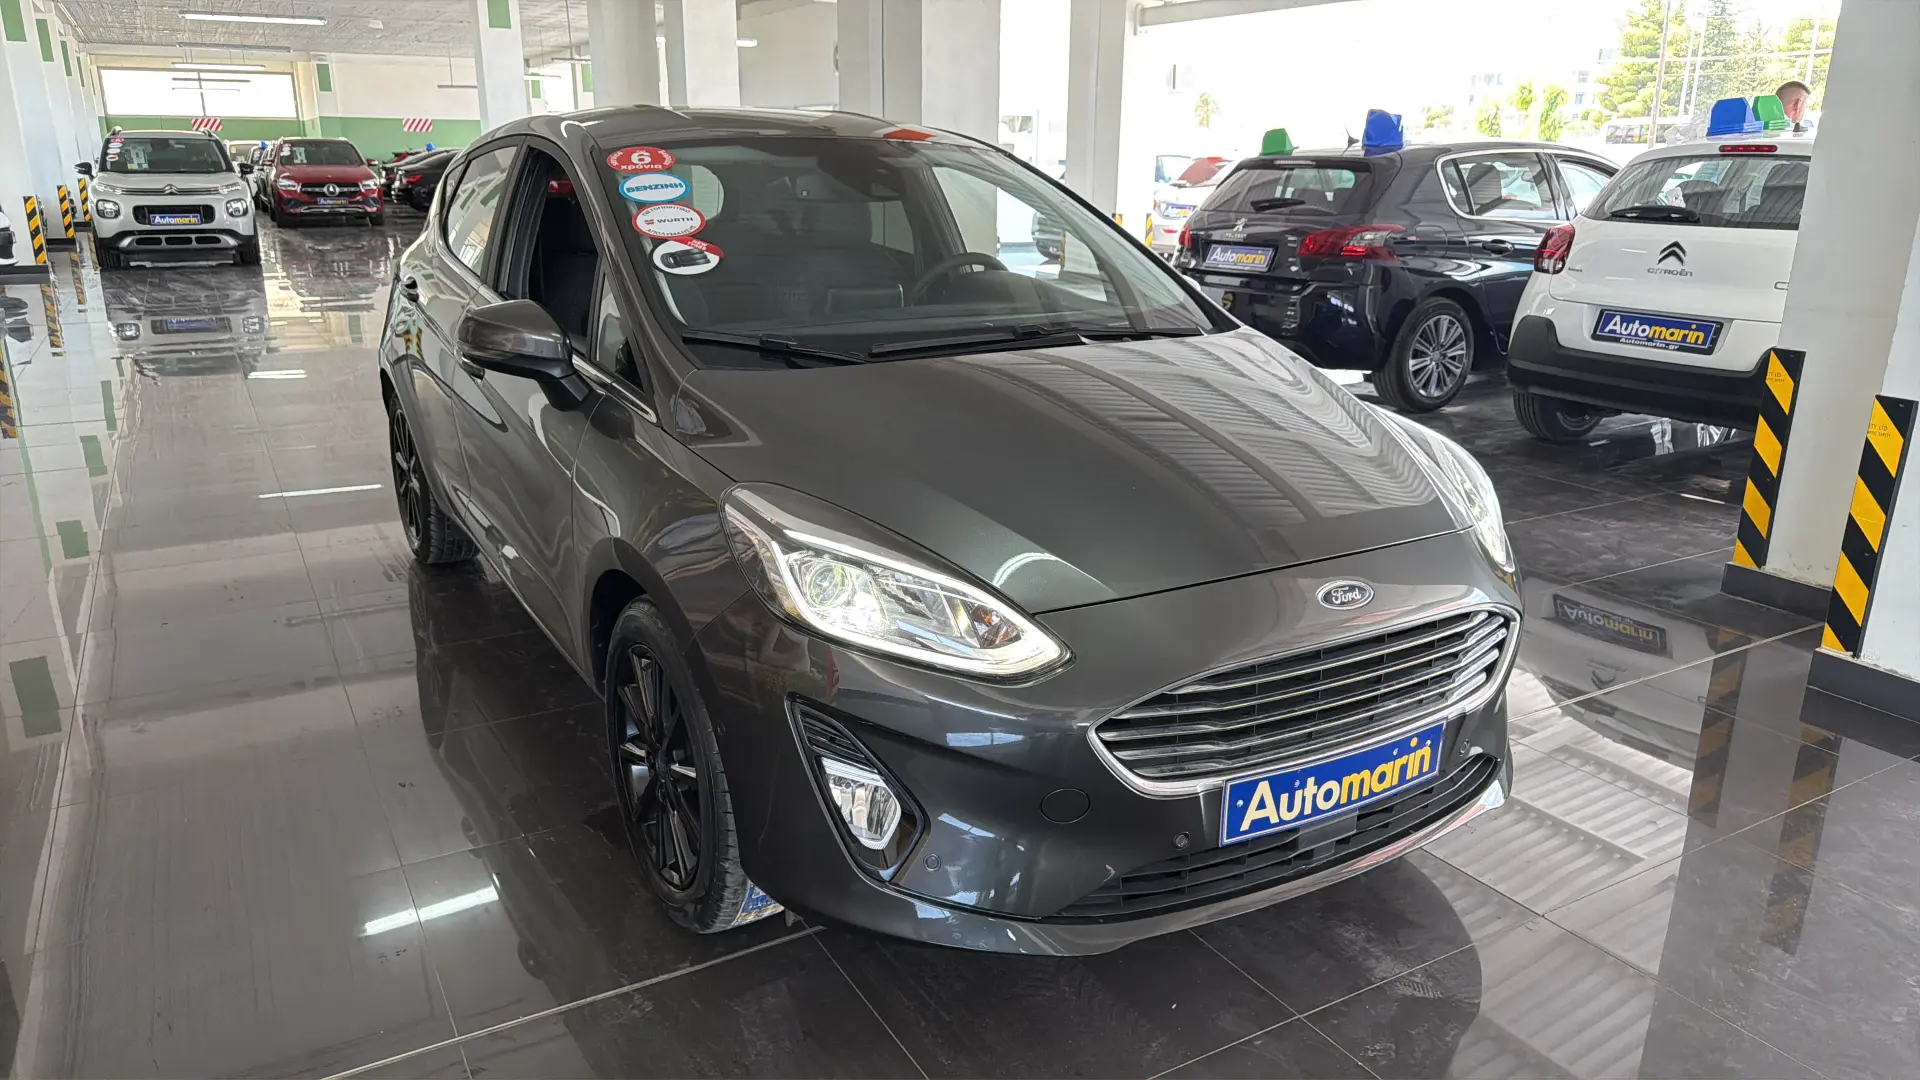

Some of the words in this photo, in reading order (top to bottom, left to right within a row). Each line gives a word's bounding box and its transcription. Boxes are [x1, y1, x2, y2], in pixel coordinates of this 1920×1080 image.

[631, 152, 651, 165] 6
[154, 215, 198, 224] Automarin
[1210, 247, 1266, 265] Automarin
[1604, 315, 1705, 345] Automarin
[1619, 338, 1680, 350] Automarin.gr
[1331, 586, 1362, 604] Ford
[1239, 736, 1432, 832] Automarin
